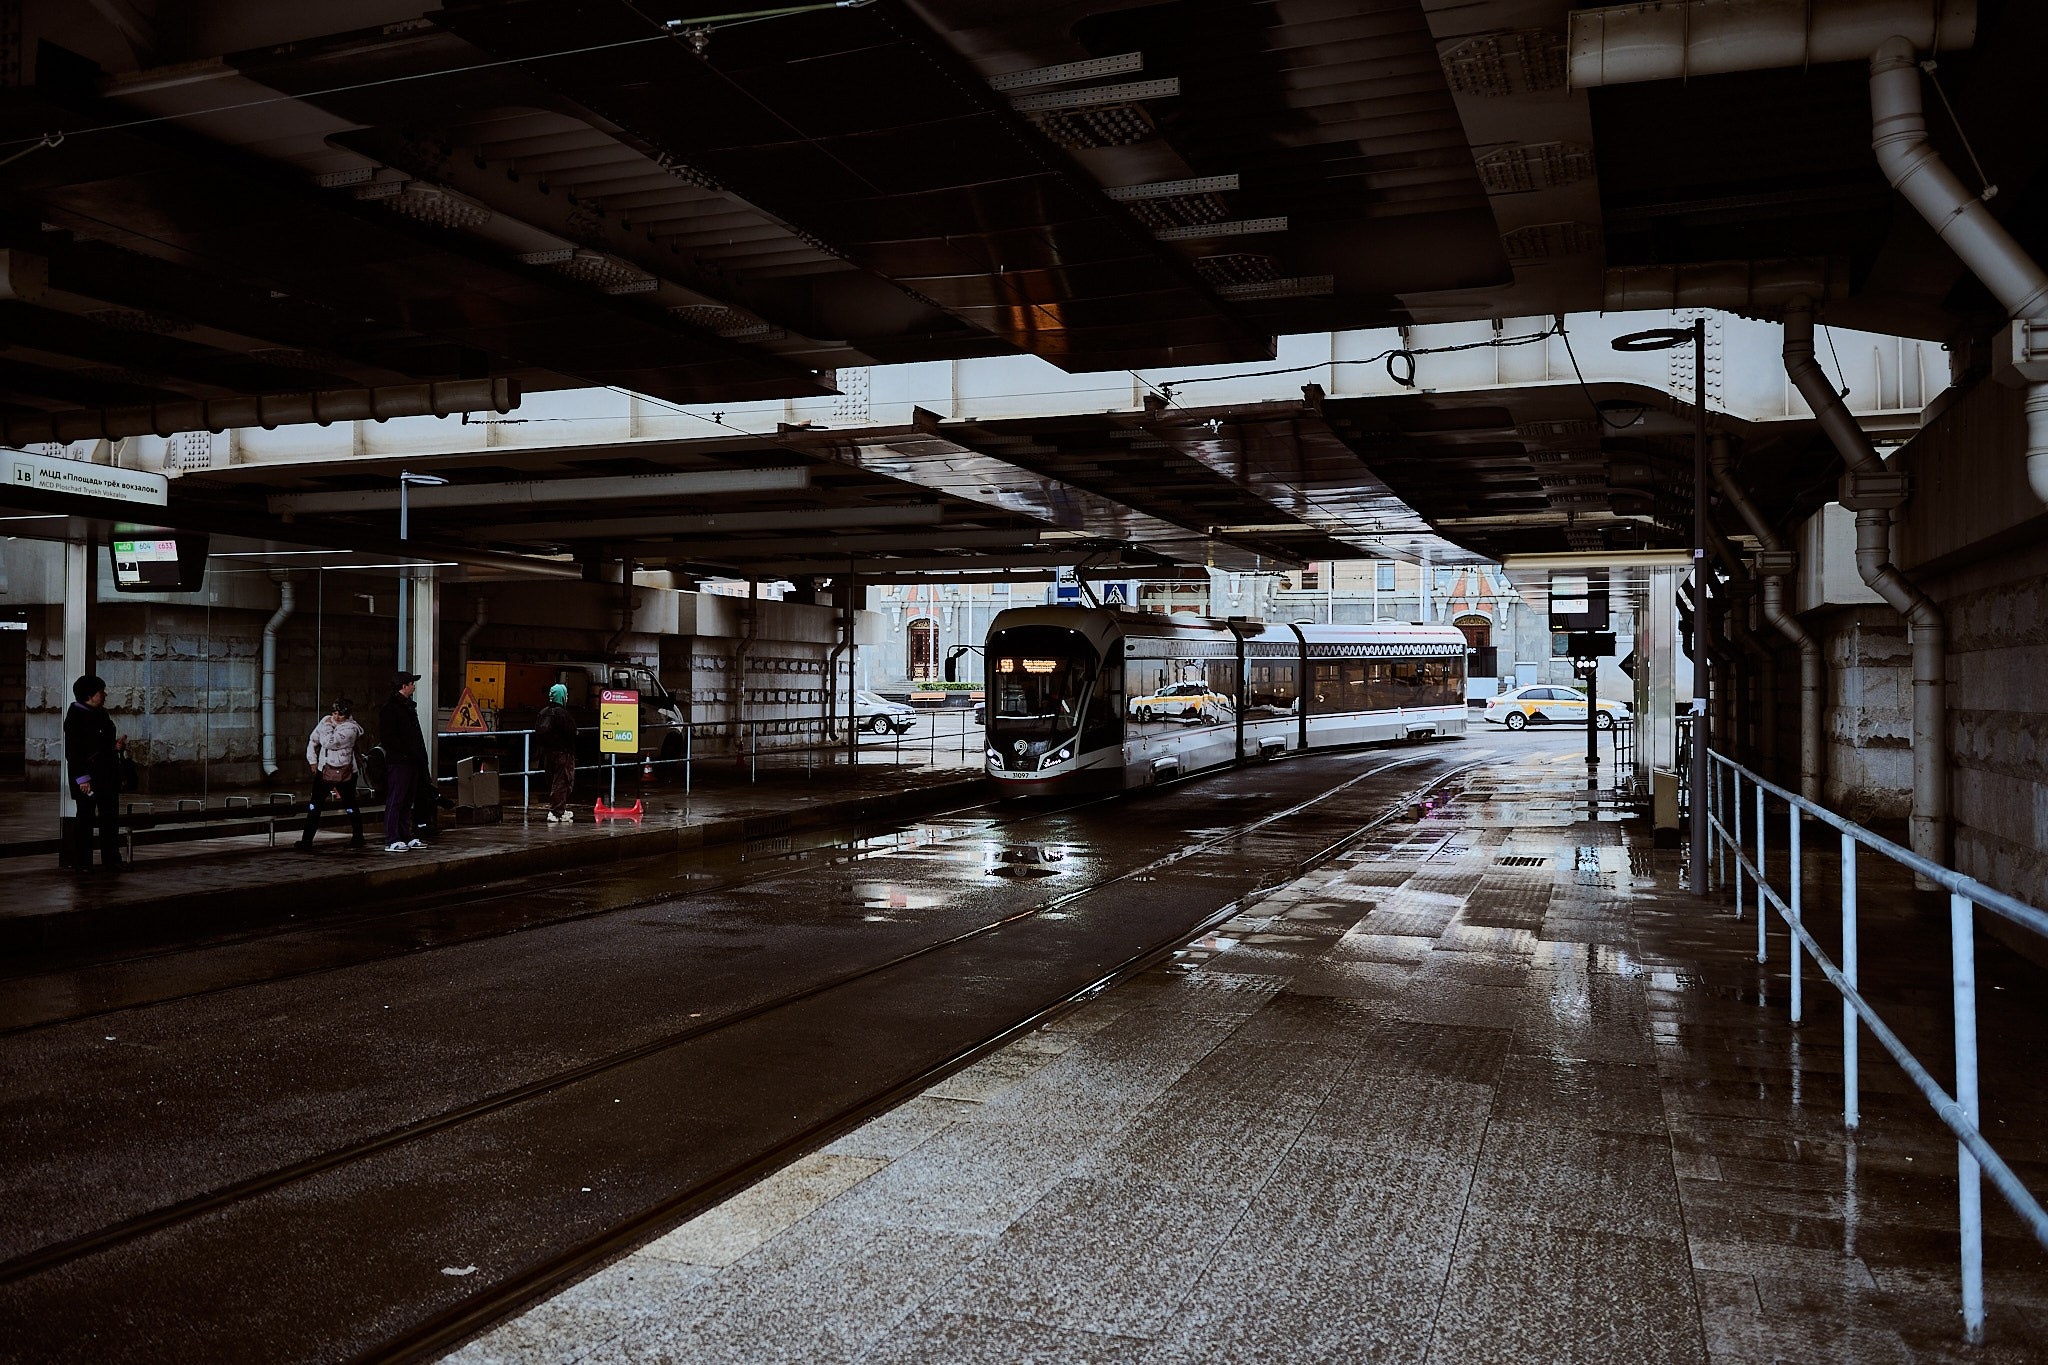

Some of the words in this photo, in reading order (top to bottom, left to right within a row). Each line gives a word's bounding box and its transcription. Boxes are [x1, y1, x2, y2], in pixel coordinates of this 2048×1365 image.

[39, 469, 61, 480] МЦД
[63, 473, 102, 486] «Площадь
[104, 480, 120, 488] трёх
[121, 483, 158, 493] вокзалов»
[56, 482, 82, 492] Ploschad
[83, 486, 101, 495] Tryokh
[103, 490, 127, 499] Vokzalov
[124, 562, 130, 570] 7
